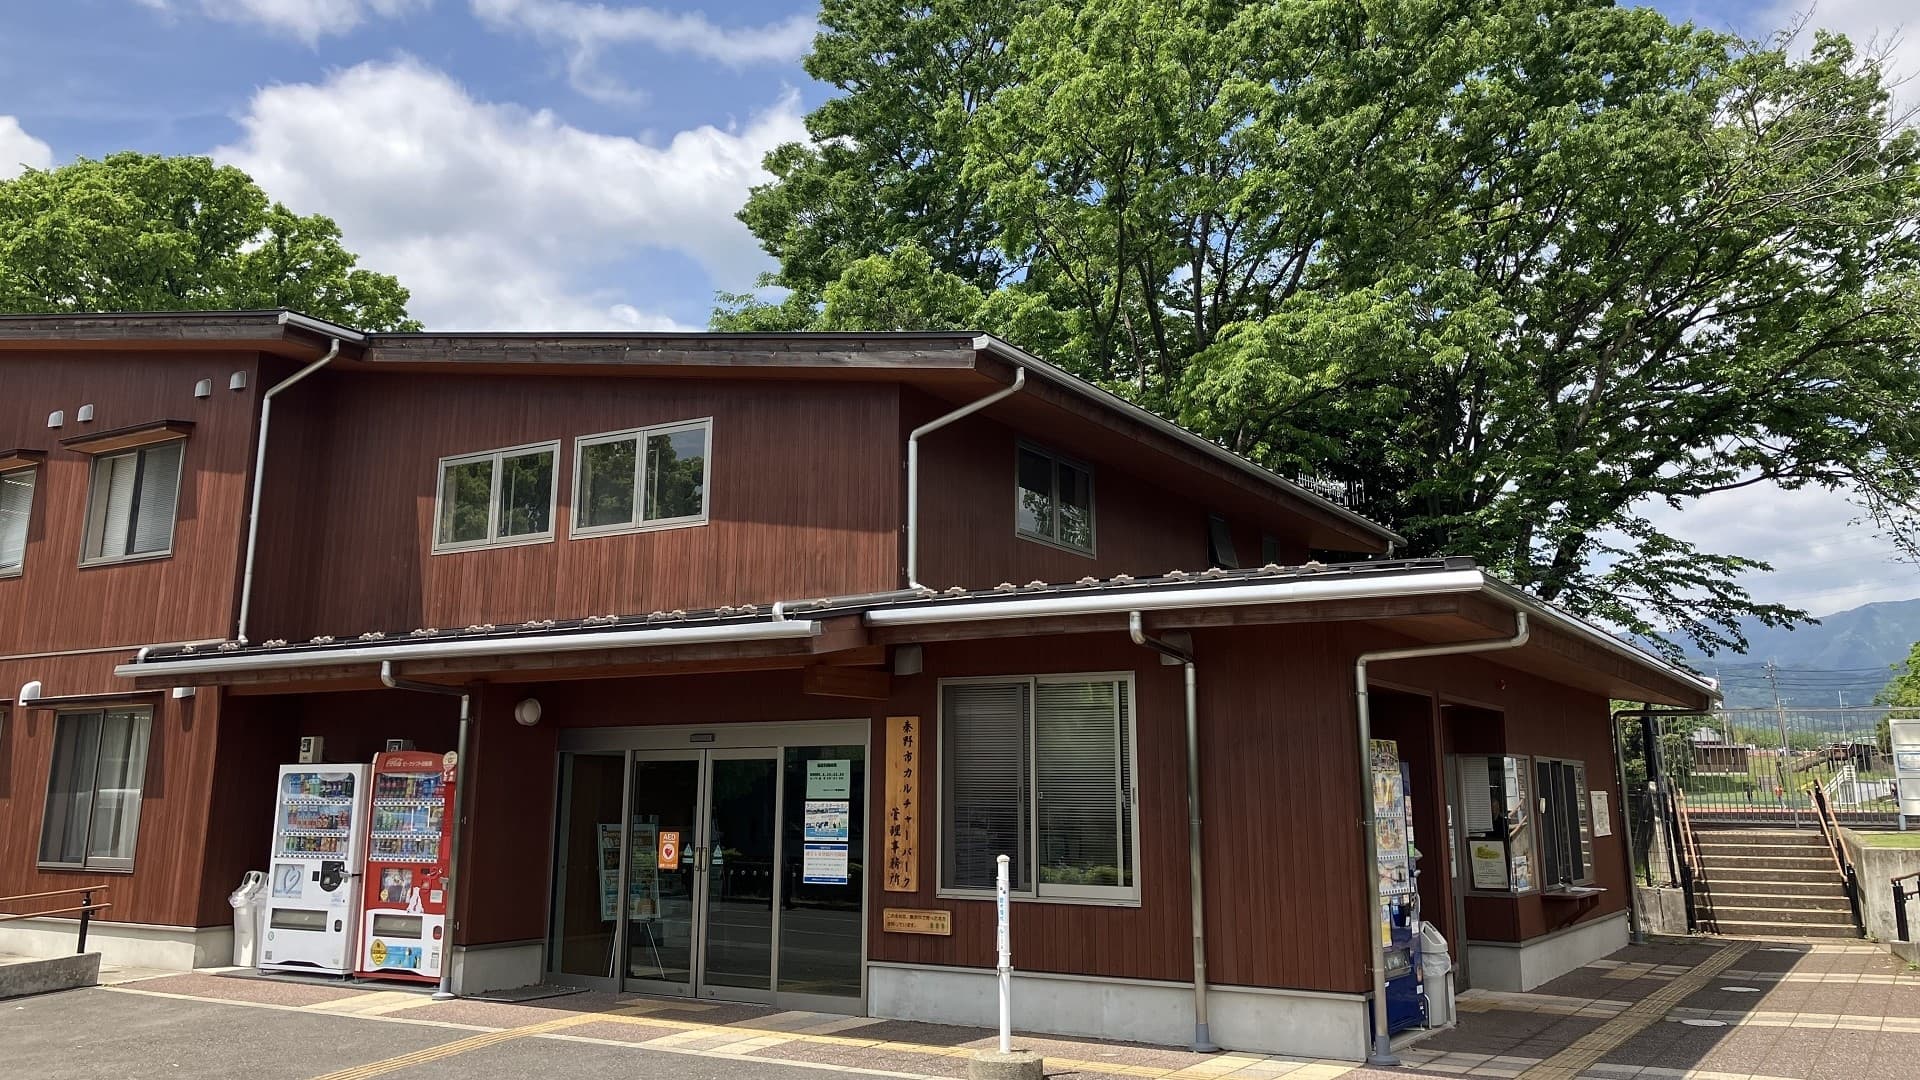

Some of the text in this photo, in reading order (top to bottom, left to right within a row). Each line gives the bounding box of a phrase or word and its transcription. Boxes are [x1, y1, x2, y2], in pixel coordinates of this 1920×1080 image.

[663, 833, 676, 841] AED
[902, 720, 913, 888] 秦野市カルチャーパーク
[889, 808, 901, 886] 管理事務所
